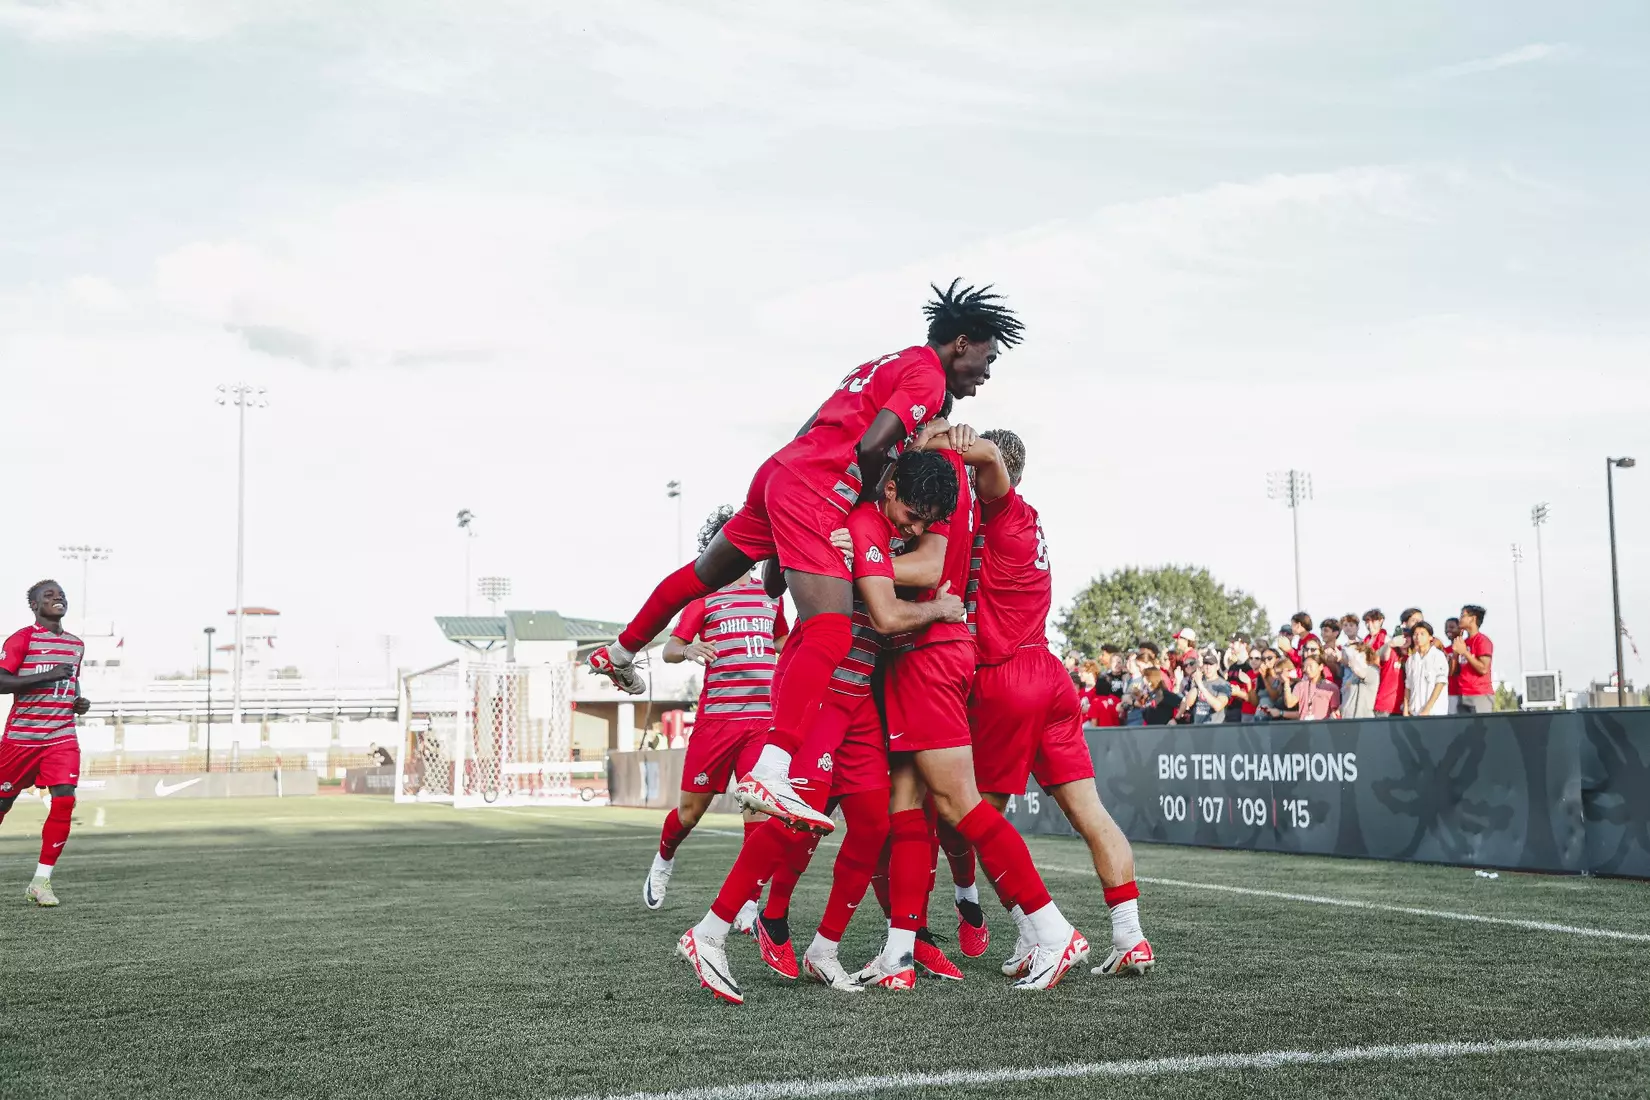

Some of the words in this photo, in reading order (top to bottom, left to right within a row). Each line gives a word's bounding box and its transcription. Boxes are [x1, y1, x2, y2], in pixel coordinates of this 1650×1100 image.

[720, 618, 748, 634] OHIO
[752, 617, 774, 634] STAT
[744, 635, 765, 658] 10
[52, 679, 70, 699] 17
[1157, 753, 1187, 781] BIG
[1190, 753, 1226, 781] TEN
[1230, 752, 1358, 782] CHAMPIONS
[1024, 791, 1040, 815] '15
[1159, 794, 1187, 822] '00
[1197, 796, 1224, 824] '07
[1237, 797, 1267, 826] '09
[1282, 799, 1310, 828] '15
